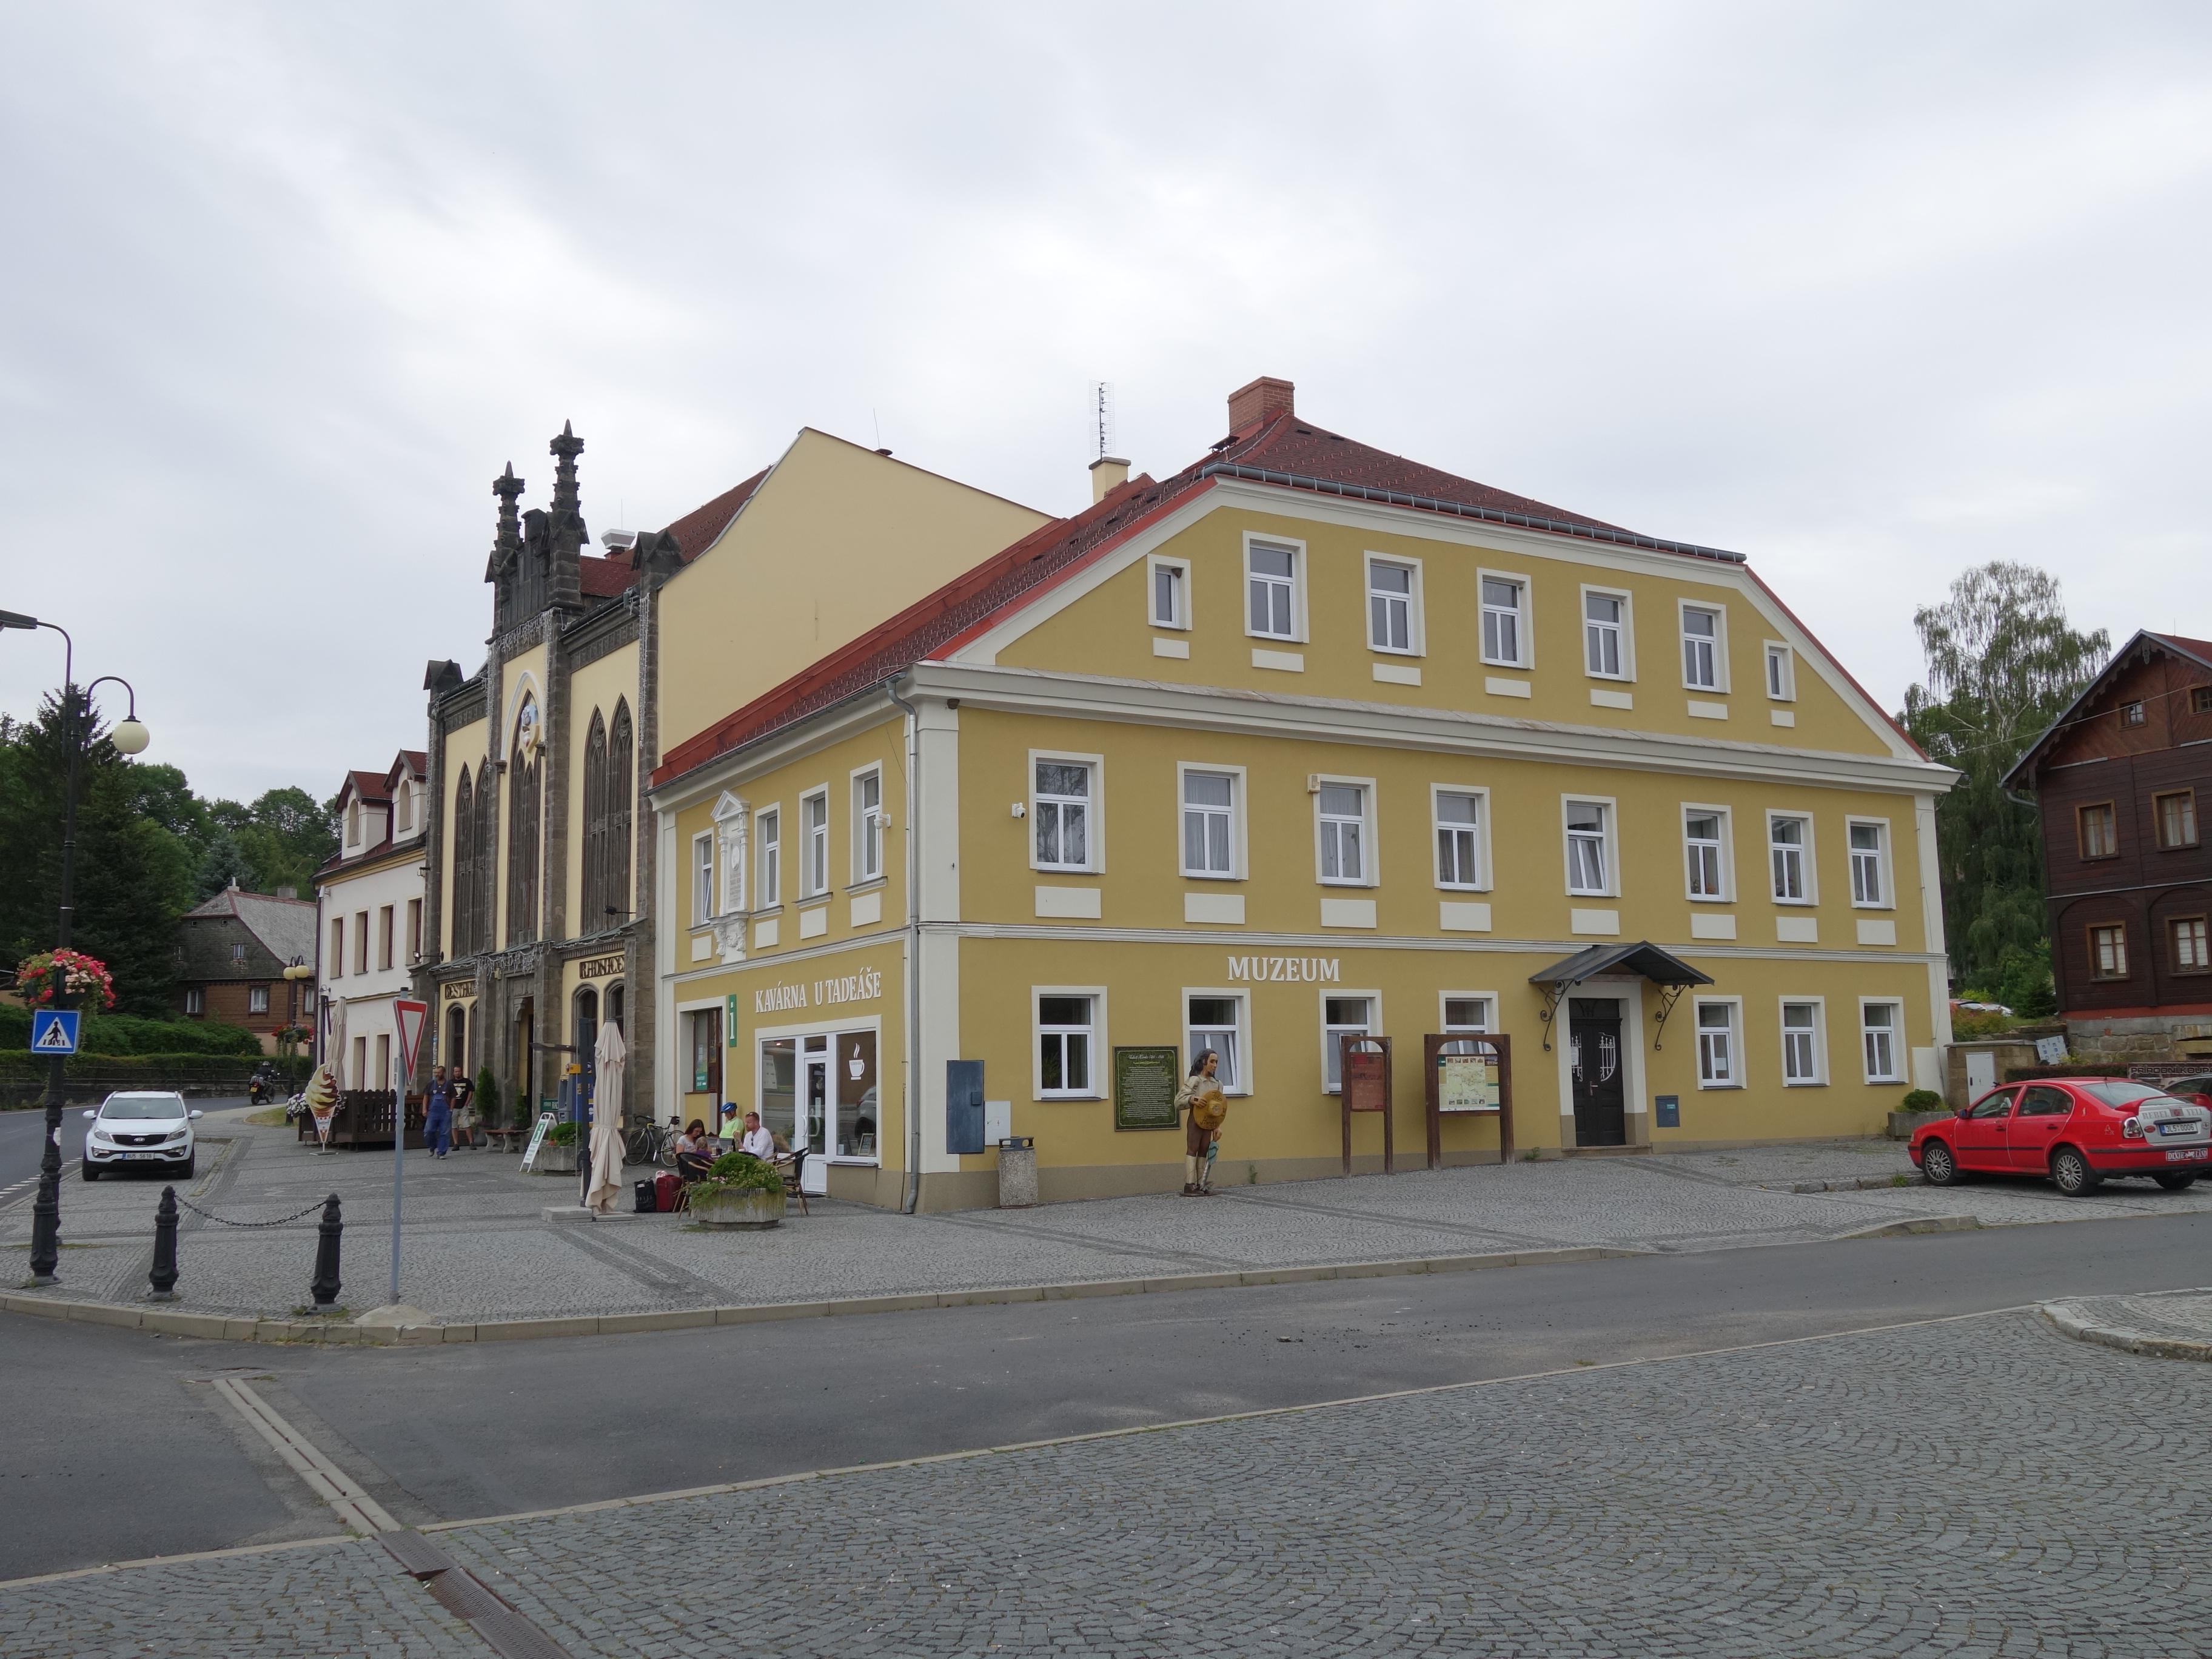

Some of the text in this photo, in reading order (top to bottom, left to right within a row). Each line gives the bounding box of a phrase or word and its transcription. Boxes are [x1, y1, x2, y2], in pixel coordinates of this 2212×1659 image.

[1227, 956, 1341, 982] MUZEUM
[755, 966, 882, 1013] KAVÁRNA U TADEÁŠE
[2142, 1110, 2170, 1120] REBEL
